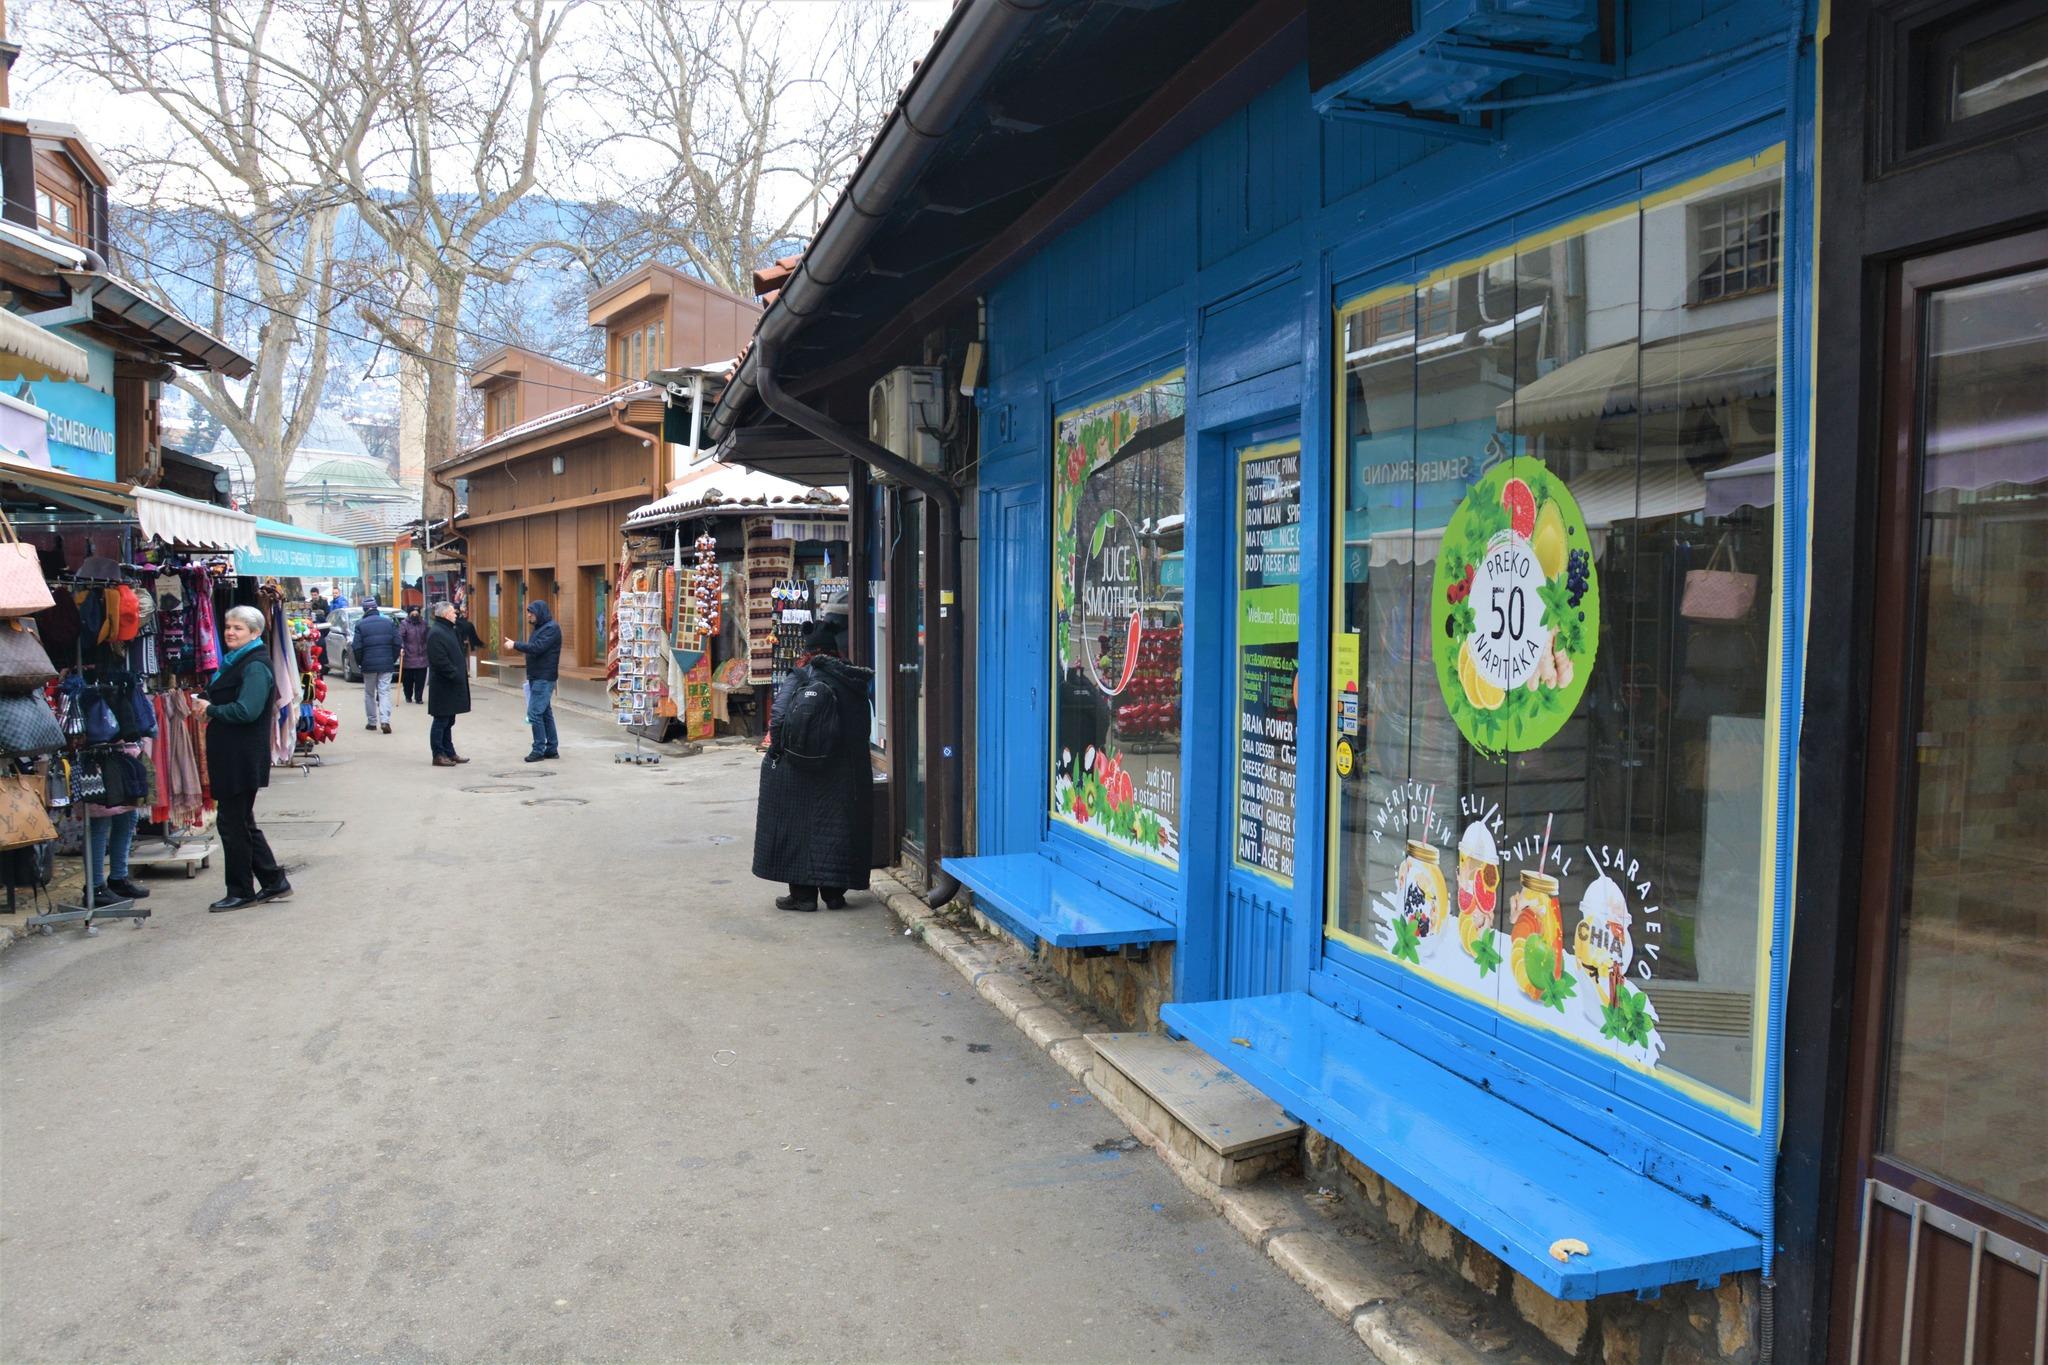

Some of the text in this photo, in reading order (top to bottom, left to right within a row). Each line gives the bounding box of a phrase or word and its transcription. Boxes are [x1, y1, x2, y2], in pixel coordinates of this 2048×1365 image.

[1246, 456, 1297, 479] ROMANTIC PINK
[1246, 508, 1262, 526] IRON
[1263, 506, 1281, 524] MAN
[1246, 530, 1273, 547] MATCHA
[1279, 528, 1294, 547] NICE
[1245, 553, 1264, 572] BODY
[1265, 554, 1286, 572] RESET
[1486, 550, 1531, 582] PREKO
[1086, 586, 1139, 618] SMOOTHIES
[1279, 608, 1297, 625] Dobro
[1491, 586, 1525, 641] 50
[1474, 633, 1540, 680] NAPITAKA
[1345, 720, 1355, 729] VISA
[1346, 705, 1356, 714] VISA
[1265, 717, 1293, 742] POWER
[1242, 738, 1254, 755] CHIA
[1241, 759, 1296, 789] CHEESECAKE PROT
[1133, 787, 1138, 801] a
[1240, 779, 1256, 798] IRON
[1256, 784, 1285, 808] BOOSTER
[1240, 798, 1264, 821] KIKIRIKI
[1266, 809, 1291, 834] GINGER
[1372, 777, 1429, 844] AMERIČKI
[1392, 804, 1451, 846] PROTEIN
[1240, 818, 1257, 839] MUSS
[1261, 828, 1281, 849] TAHINI
[1239, 837, 1279, 871] ANTI-AGE
[1513, 834, 1572, 877] VITAL
[1601, 844, 1662, 981] SARAJEVO
[1577, 921, 1623, 959] CHIA
